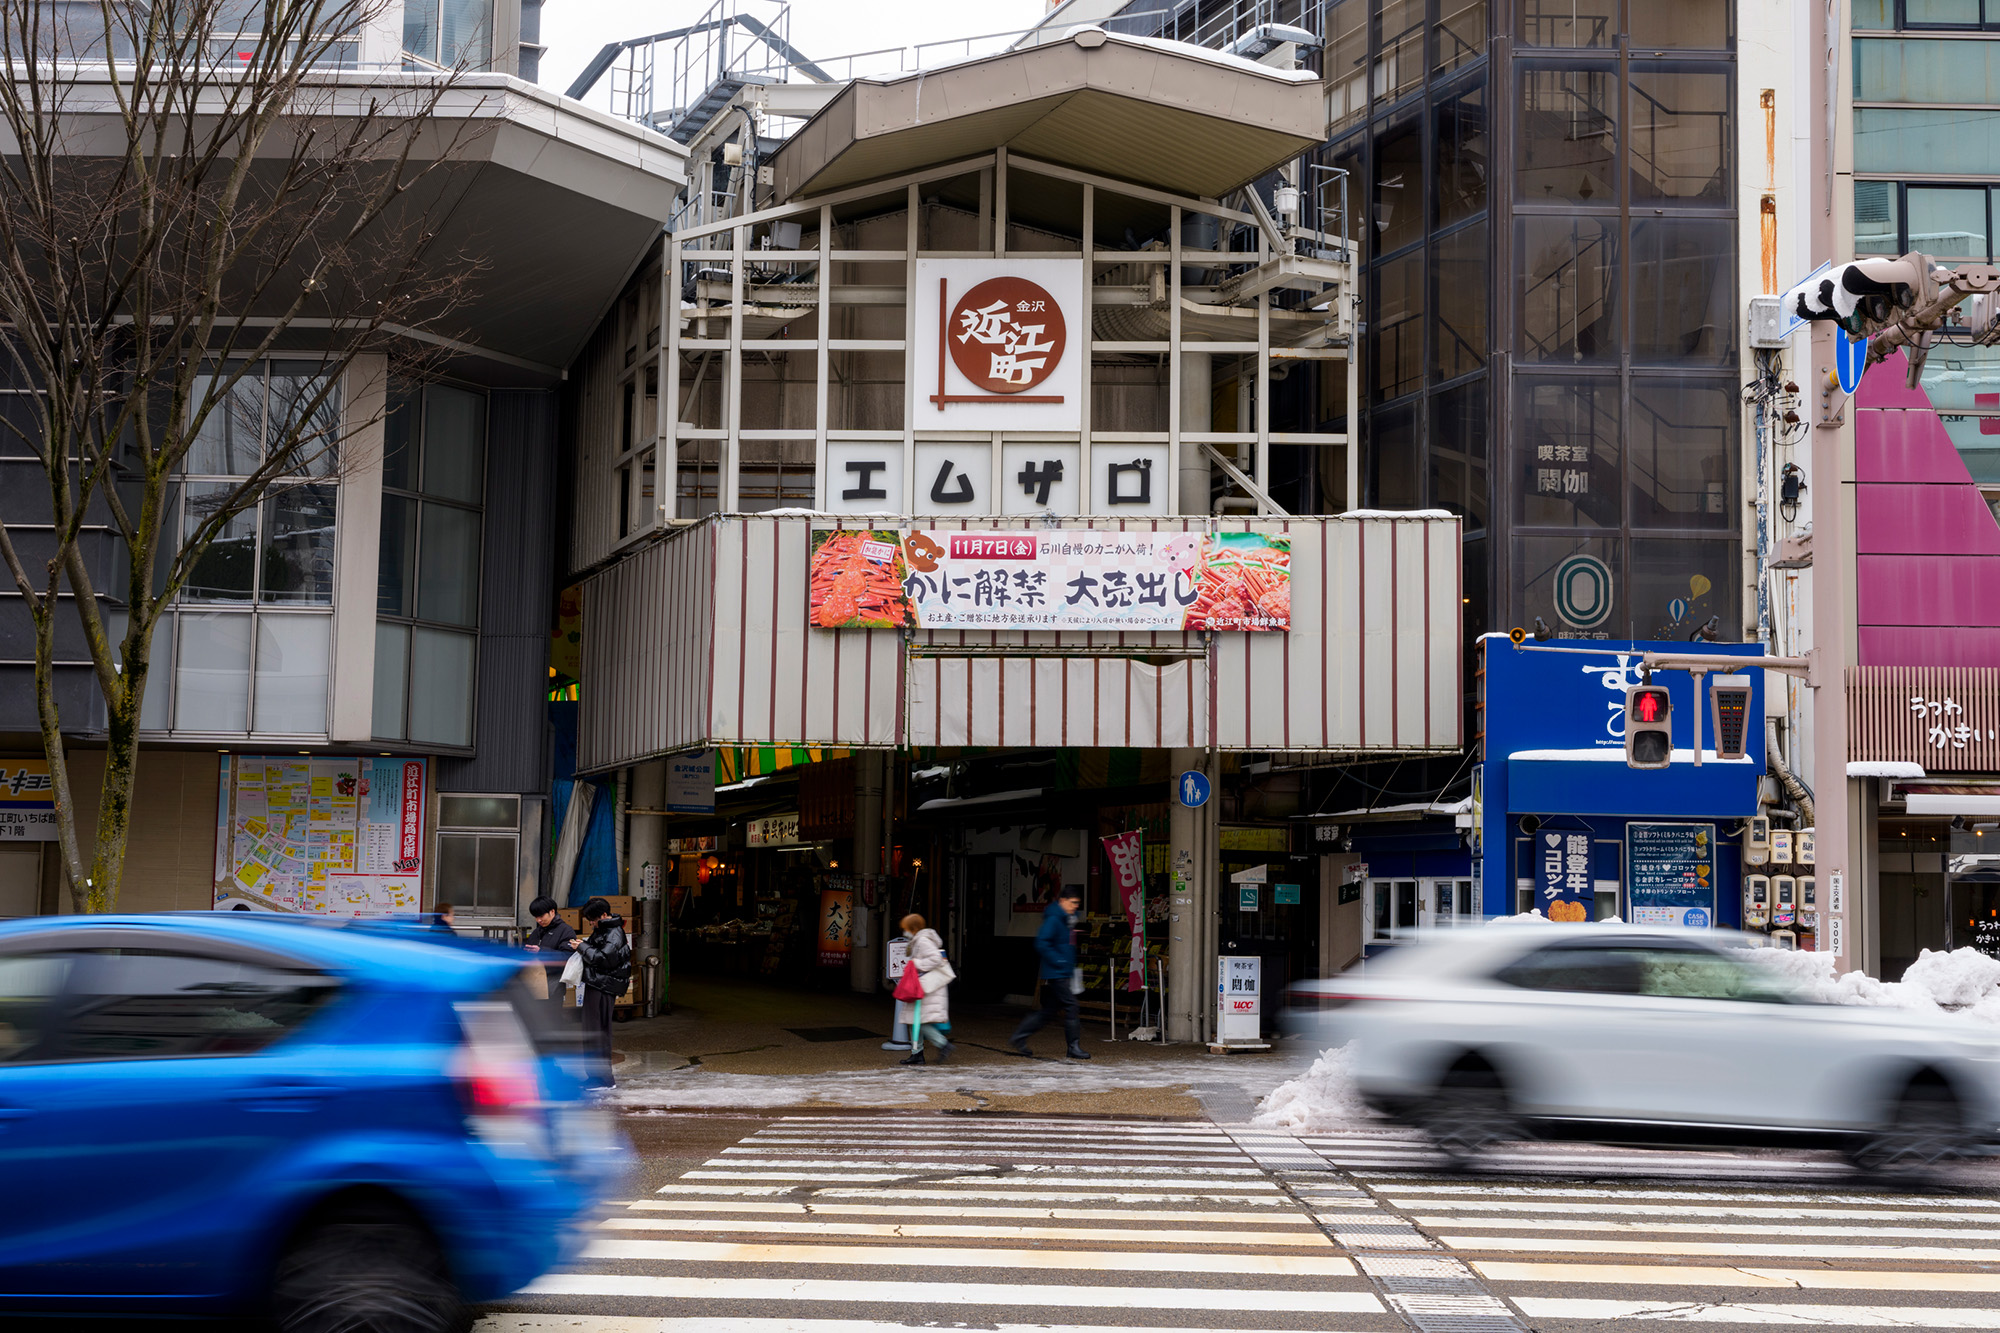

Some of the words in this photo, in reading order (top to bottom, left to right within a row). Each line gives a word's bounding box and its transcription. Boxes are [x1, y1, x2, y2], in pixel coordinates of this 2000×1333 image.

[1016, 300, 1046, 312] 金沢
[956, 299, 1055, 384] 近江町
[1538, 445, 1588, 462] 喫茶室
[954, 539, 1033, 556] 11月7日(金)
[903, 568, 1047, 608] かに解禁
[1064, 569, 1199, 608] 大売出し
[1911, 696, 1963, 719] うつわ
[1928, 722, 1995, 749] かきい
[403, 765, 419, 858] 近江町市場商店街
[394, 857, 421, 873] Map
[1543, 849, 1563, 900] コロッケ
[1566, 835, 1588, 893] 能登牛
[824, 901, 844, 940] 大倉
